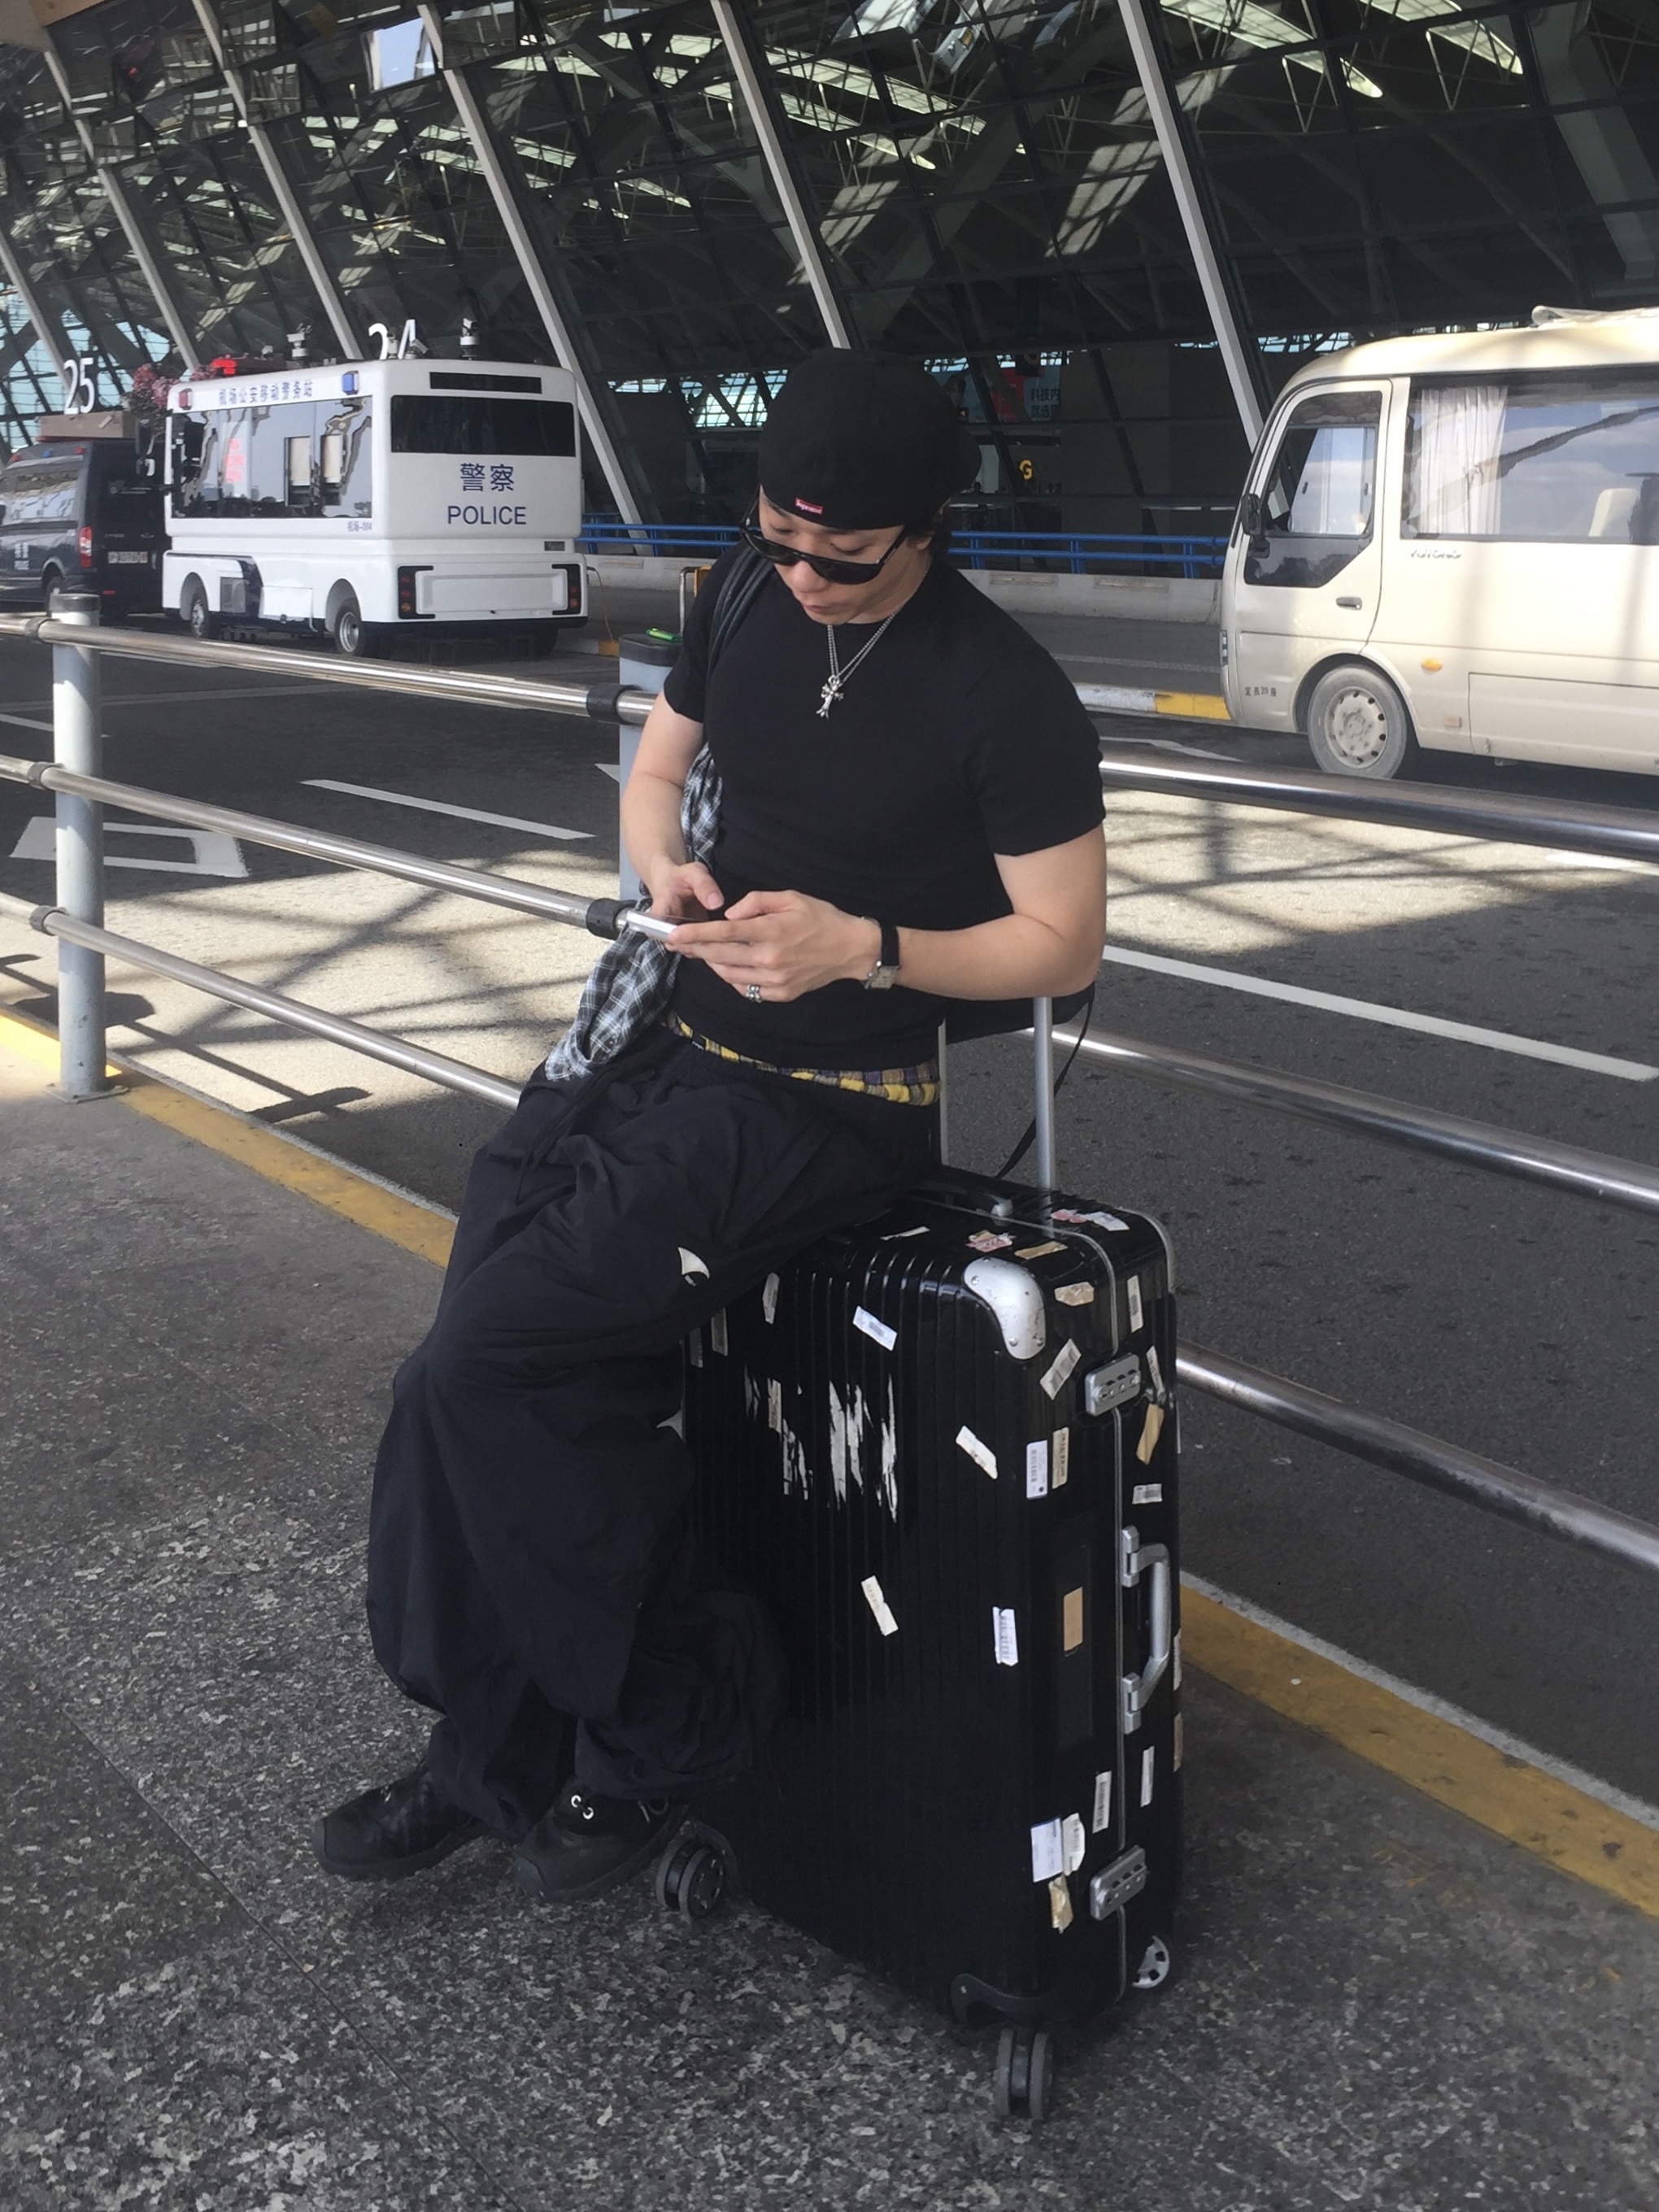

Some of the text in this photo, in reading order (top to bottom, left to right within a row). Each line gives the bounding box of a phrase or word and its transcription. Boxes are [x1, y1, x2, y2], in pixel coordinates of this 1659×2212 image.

[63, 357, 95, 415] 25
[460, 463, 515, 492] 警察
[448, 505, 527, 525] POLICE
